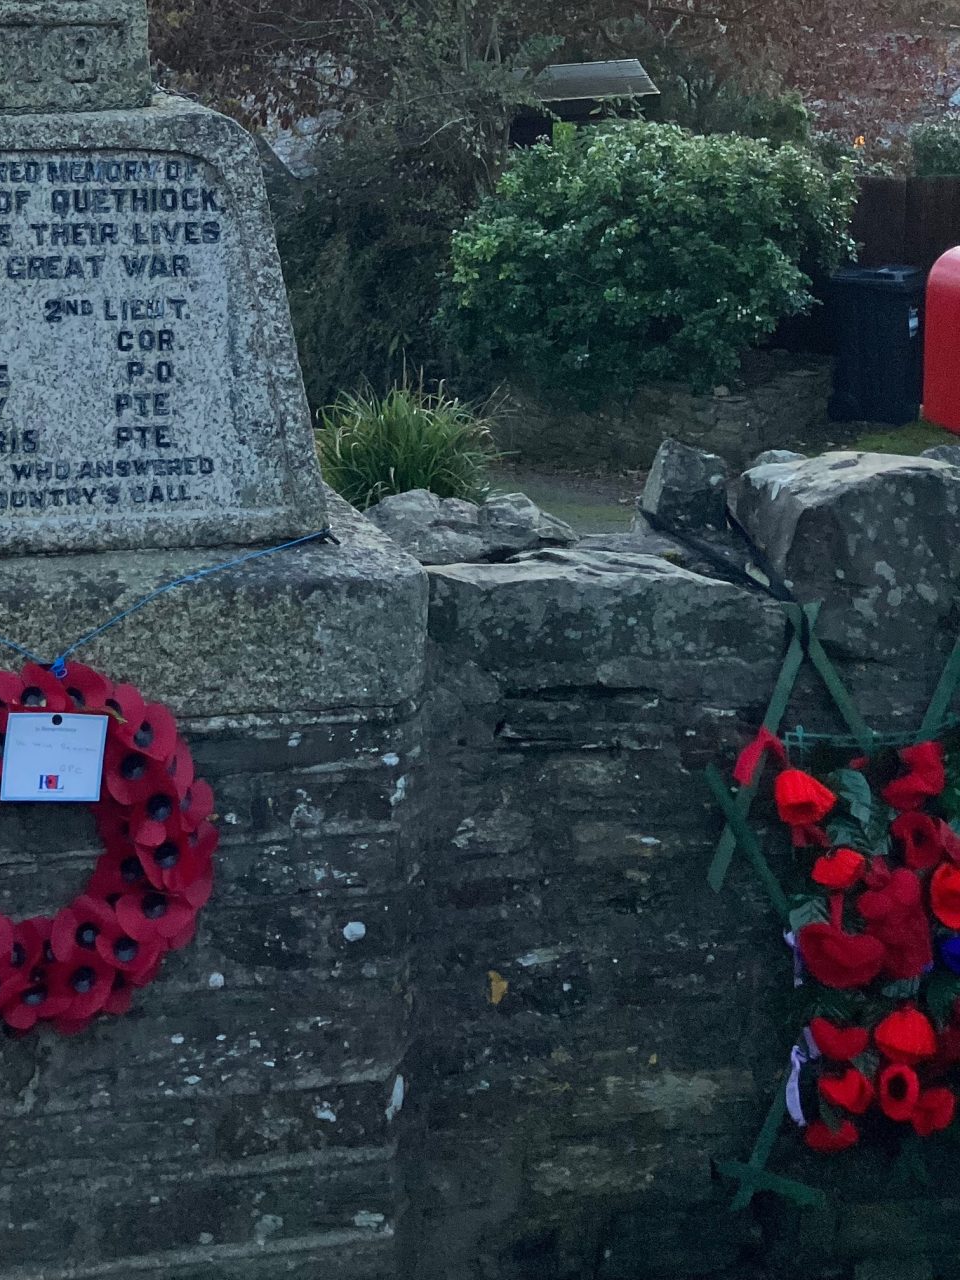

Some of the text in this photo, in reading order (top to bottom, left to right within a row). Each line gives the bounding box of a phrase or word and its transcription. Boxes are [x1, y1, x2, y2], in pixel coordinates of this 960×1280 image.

[46, 160, 159, 183] MEMORY
[30, 222, 118, 246] THEIR
[134, 221, 221, 245] LIVES
[7, 255, 106, 279] GREAT
[121, 254, 189, 277] WAR
[44, 299, 93, 322] 2ND
[11, 460, 70, 480] WHO
[76, 455, 214, 478] ANSWERED
